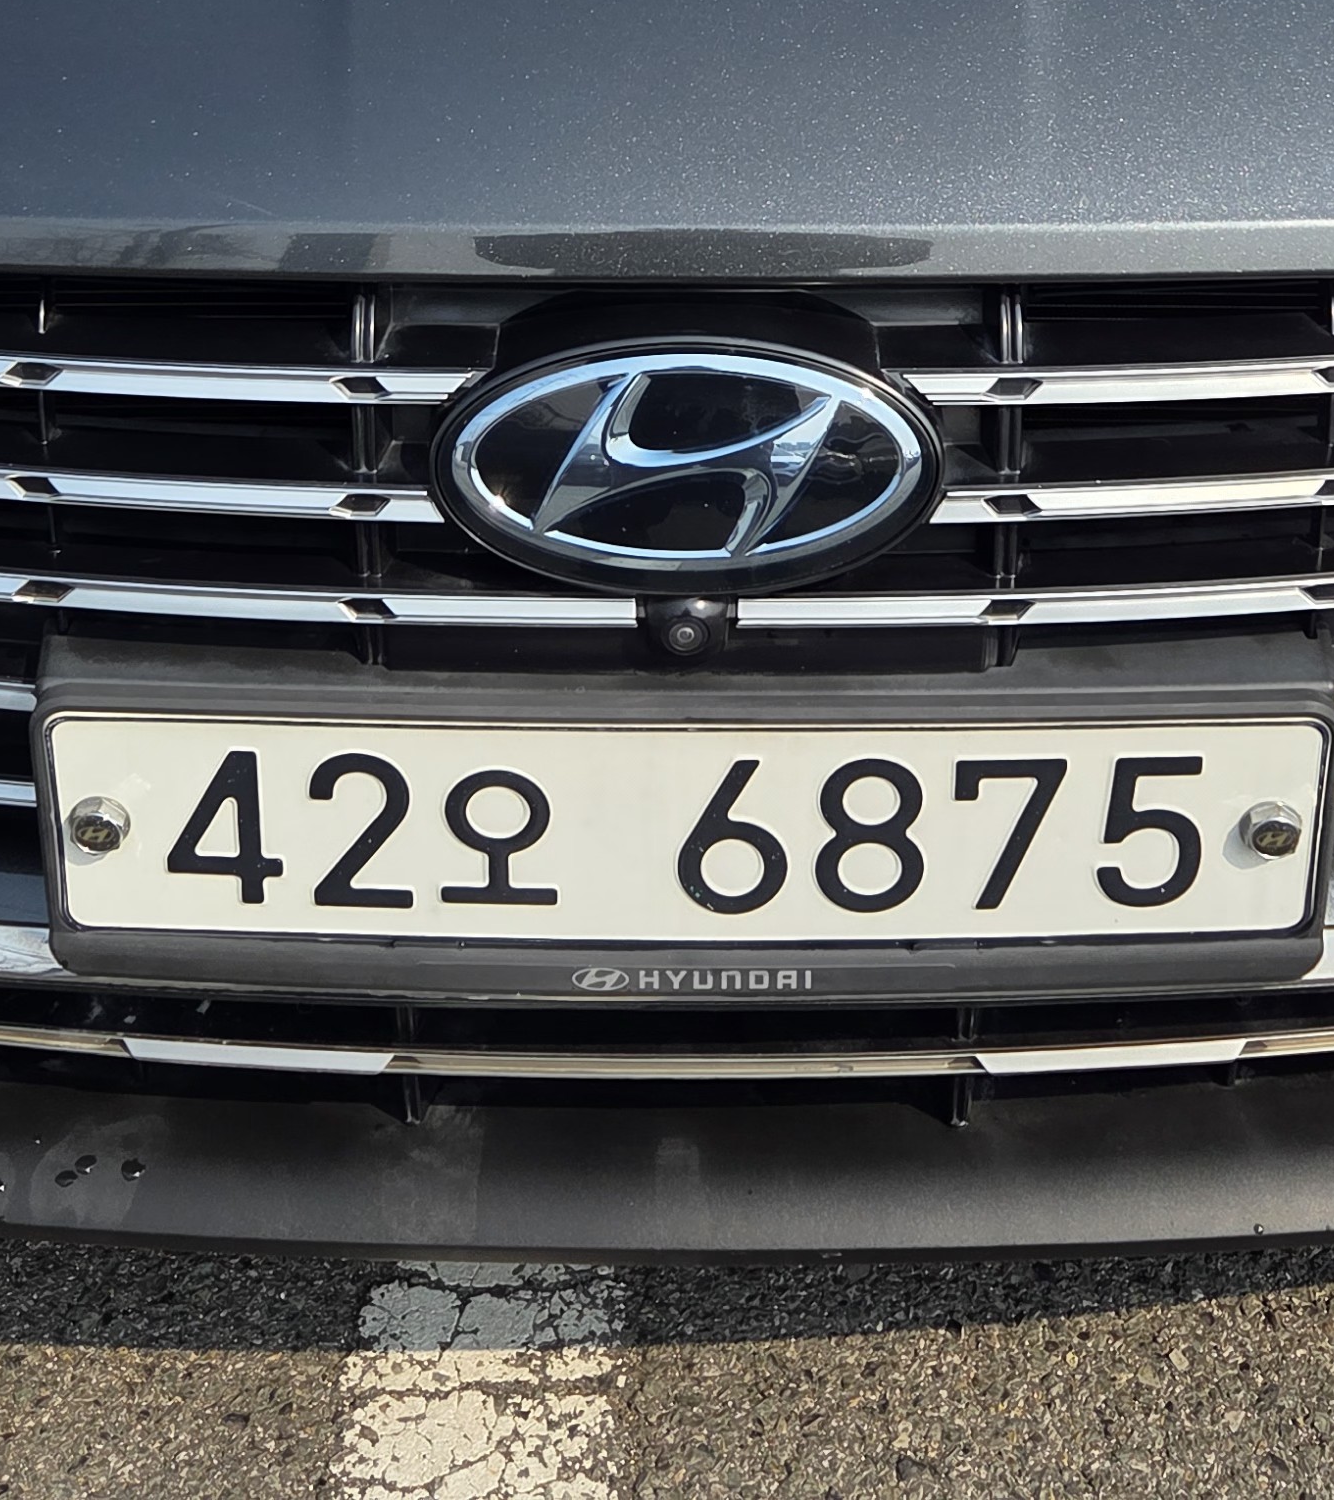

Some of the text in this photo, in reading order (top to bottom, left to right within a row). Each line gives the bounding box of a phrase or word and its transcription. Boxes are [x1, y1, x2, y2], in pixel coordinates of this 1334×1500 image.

[166, 749, 1204, 916] 42오 6875
[639, 969, 812, 990] HYUNDAI
